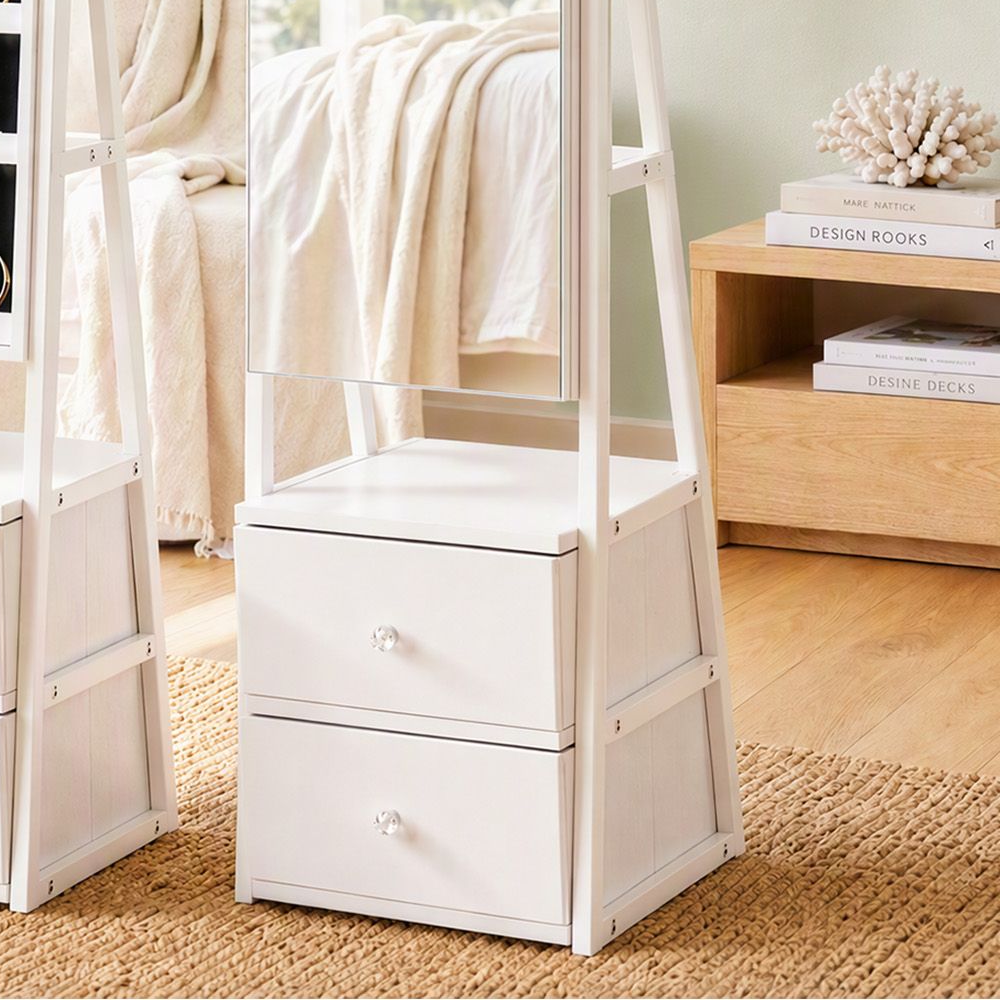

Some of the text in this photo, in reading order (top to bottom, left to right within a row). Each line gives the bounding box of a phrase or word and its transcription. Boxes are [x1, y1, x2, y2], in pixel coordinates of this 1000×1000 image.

[874, 201, 916, 212] NATTICK
[810, 226, 927, 246] DESIGN ROOKS
[868, 375, 976, 395] DESINE DECKS
